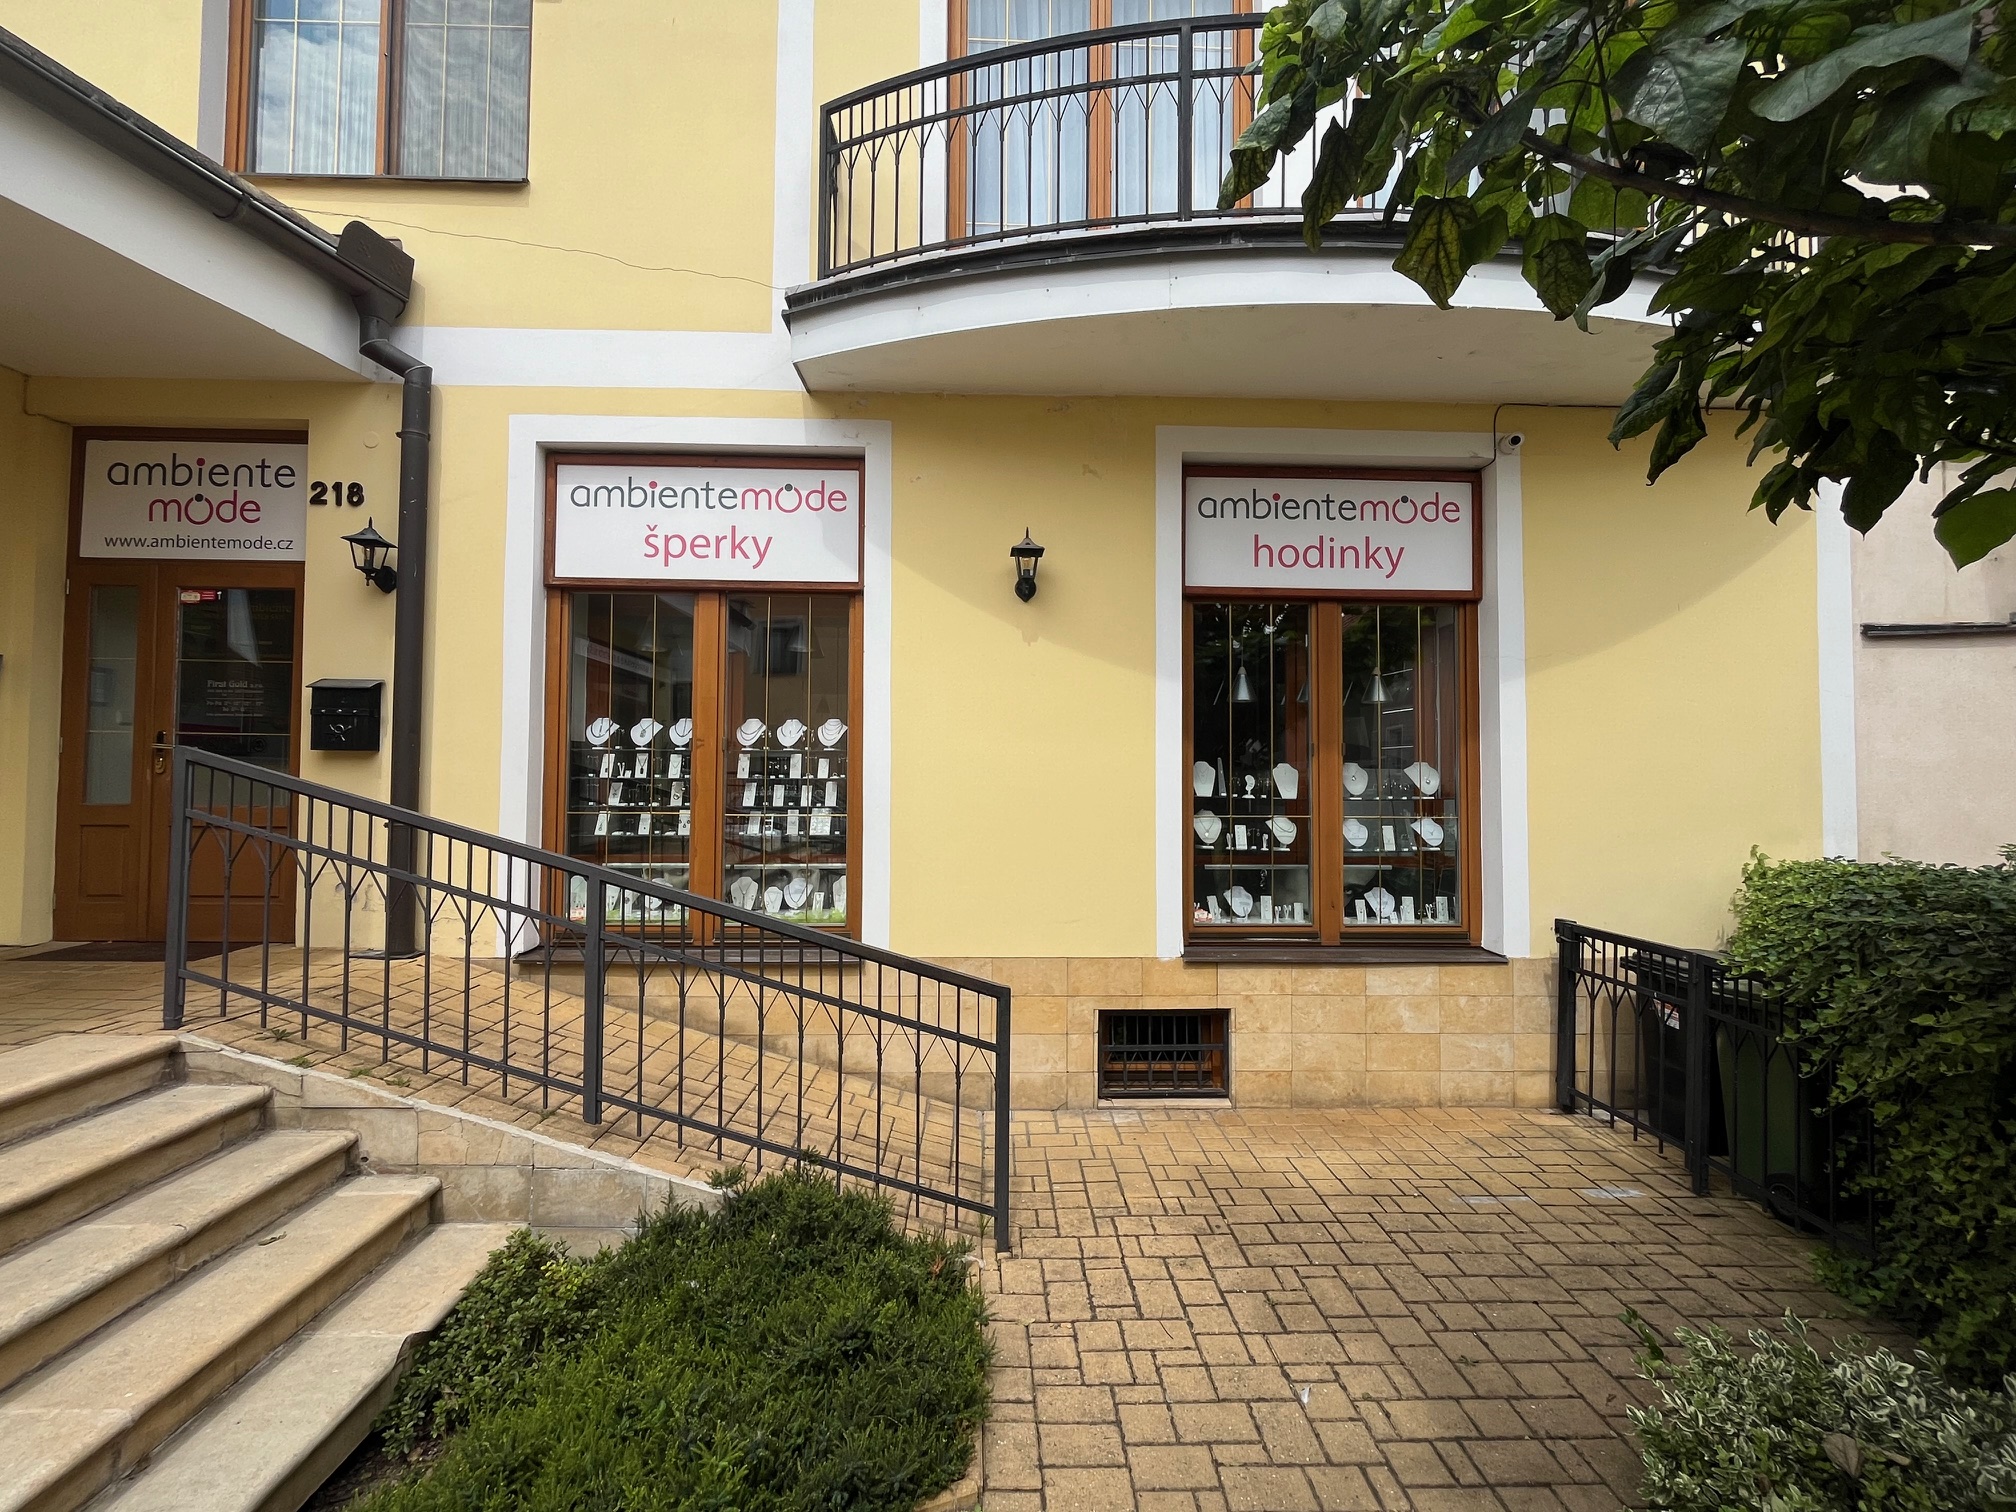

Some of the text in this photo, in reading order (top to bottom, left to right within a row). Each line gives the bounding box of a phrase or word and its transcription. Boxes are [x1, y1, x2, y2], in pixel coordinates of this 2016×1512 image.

[107, 453, 296, 488] ambiente
[310, 481, 365, 507] 218
[104, 534, 294, 551] www.ambientemode.cz
[644, 524, 773, 569] šperky
[1254, 535, 1405, 579] hodinky
[207, 679, 226, 688] First
[228, 679, 248, 688] Gold
